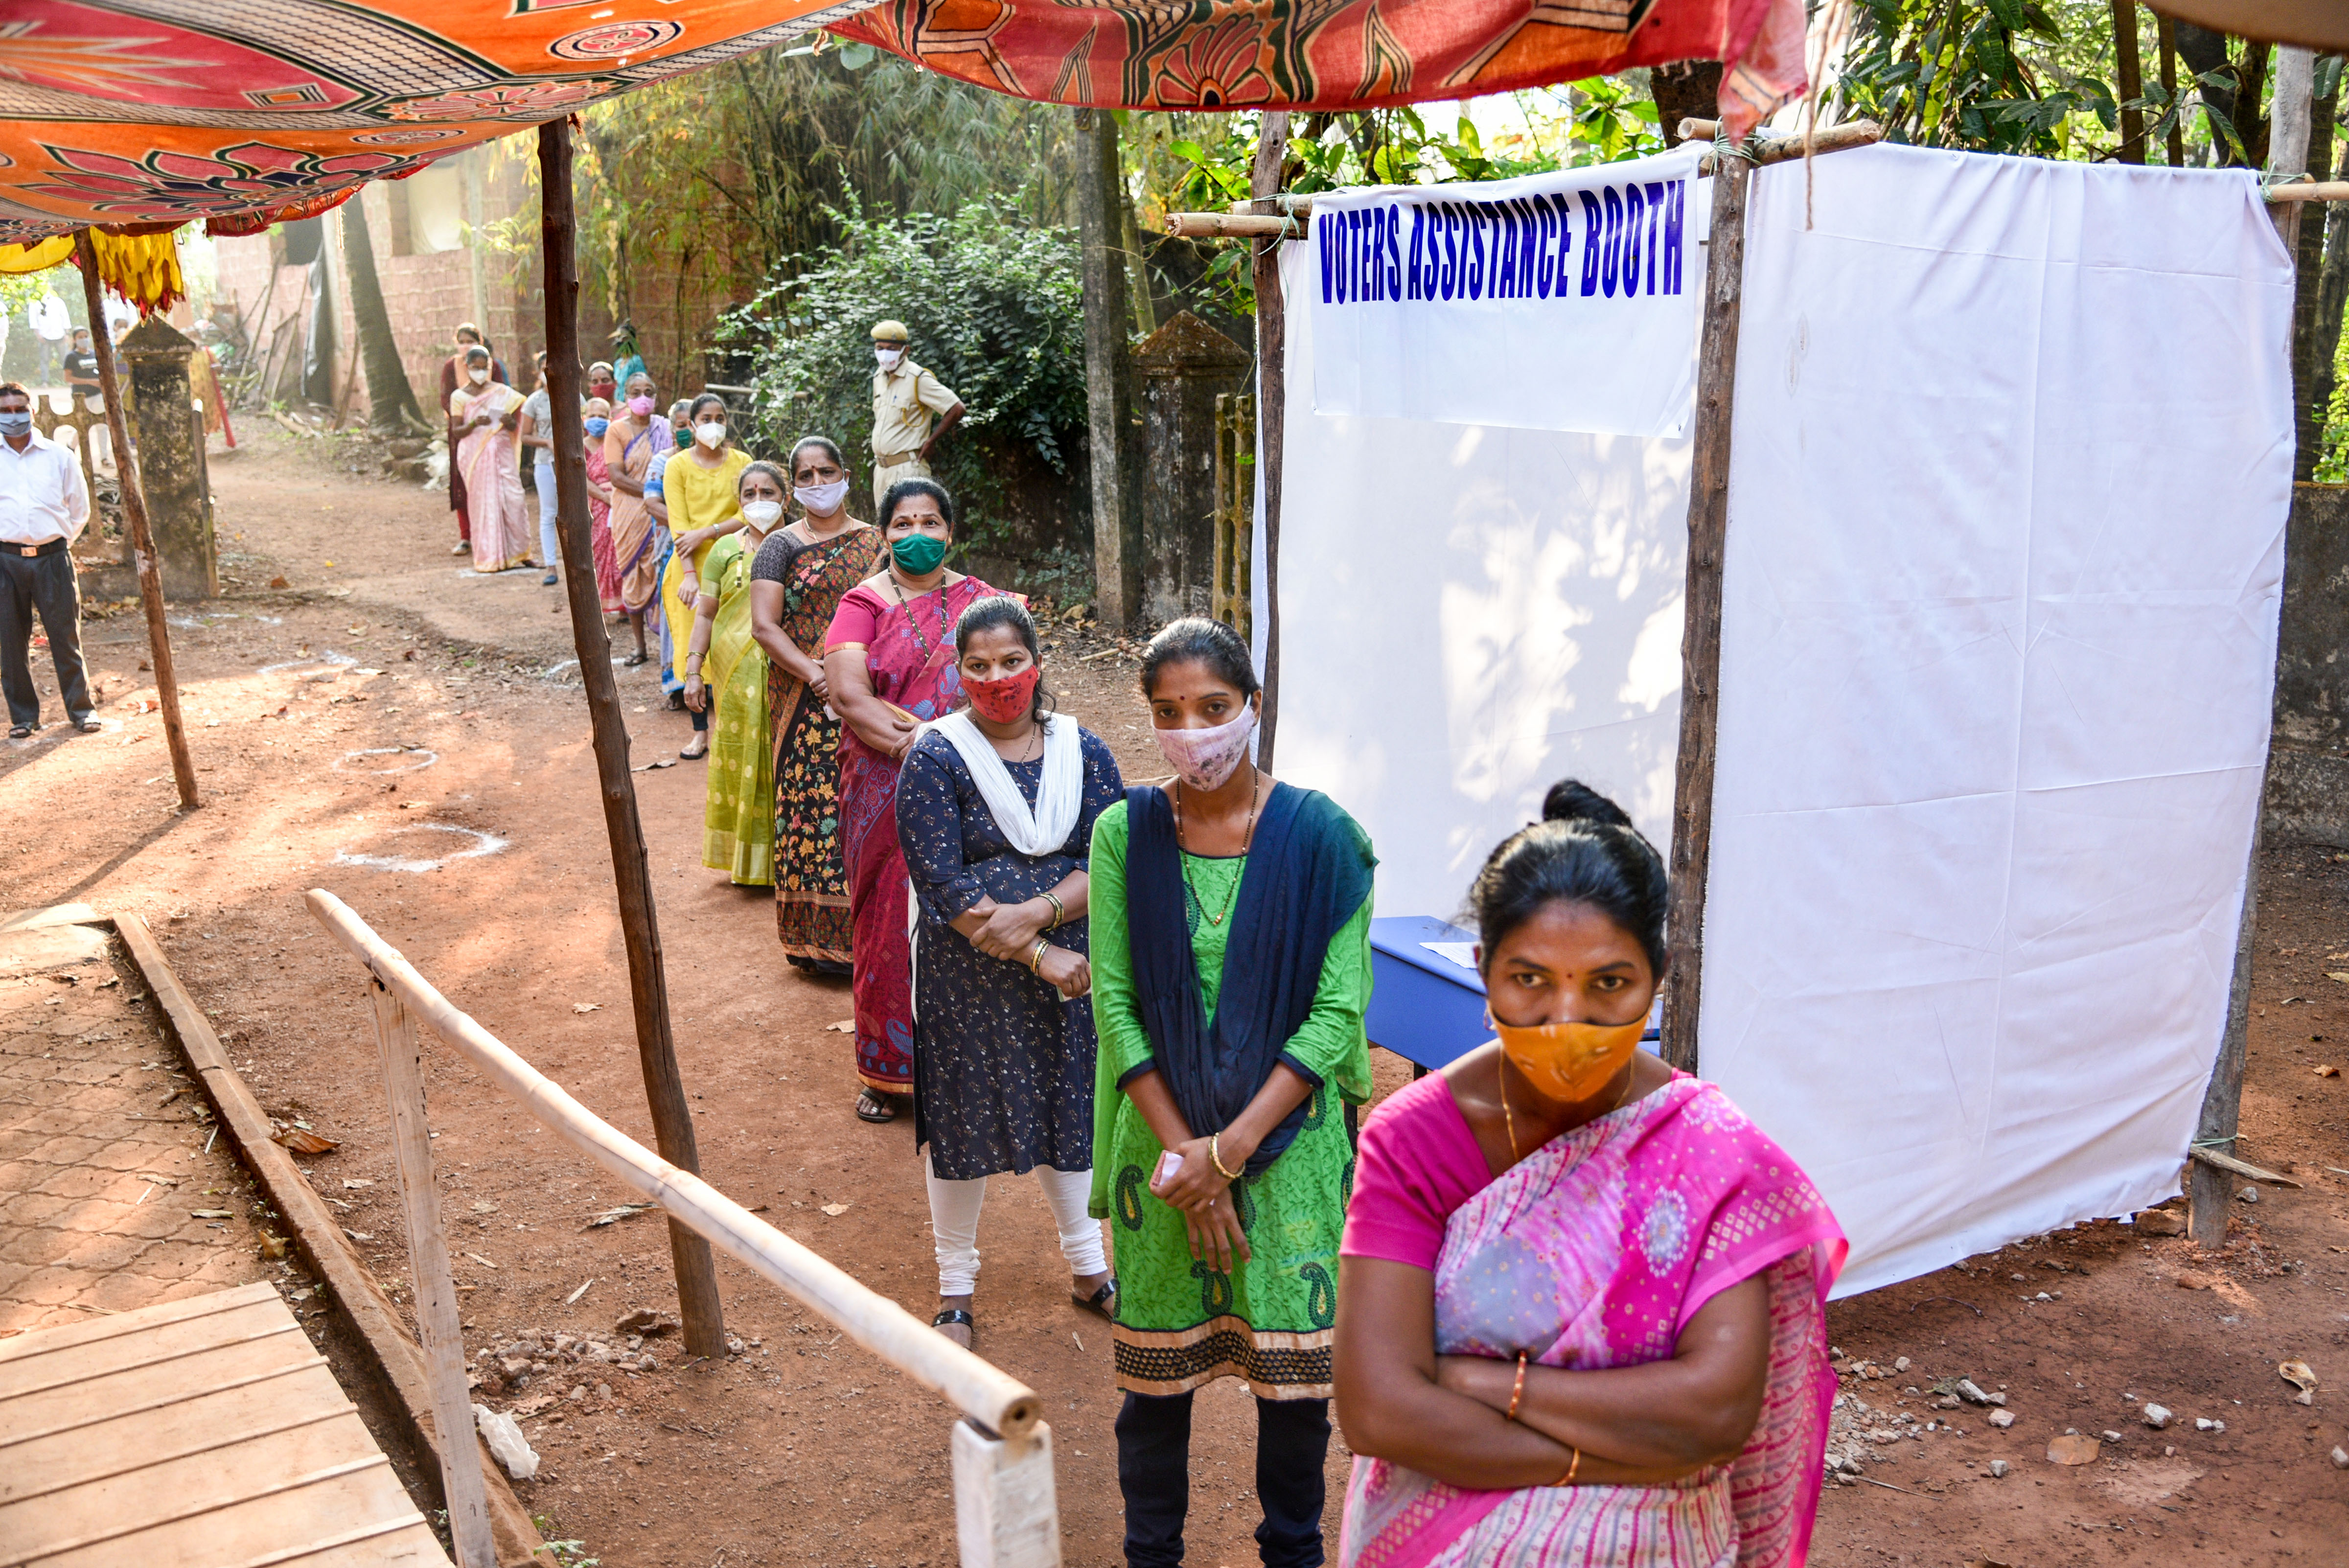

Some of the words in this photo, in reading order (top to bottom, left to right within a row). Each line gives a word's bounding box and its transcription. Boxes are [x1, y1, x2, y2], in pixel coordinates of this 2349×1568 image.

[1319, 204, 1402, 304] VOTERS
[1407, 193, 1571, 301] ASSISTANCE
[1578, 180, 1685, 299] BOOTH
